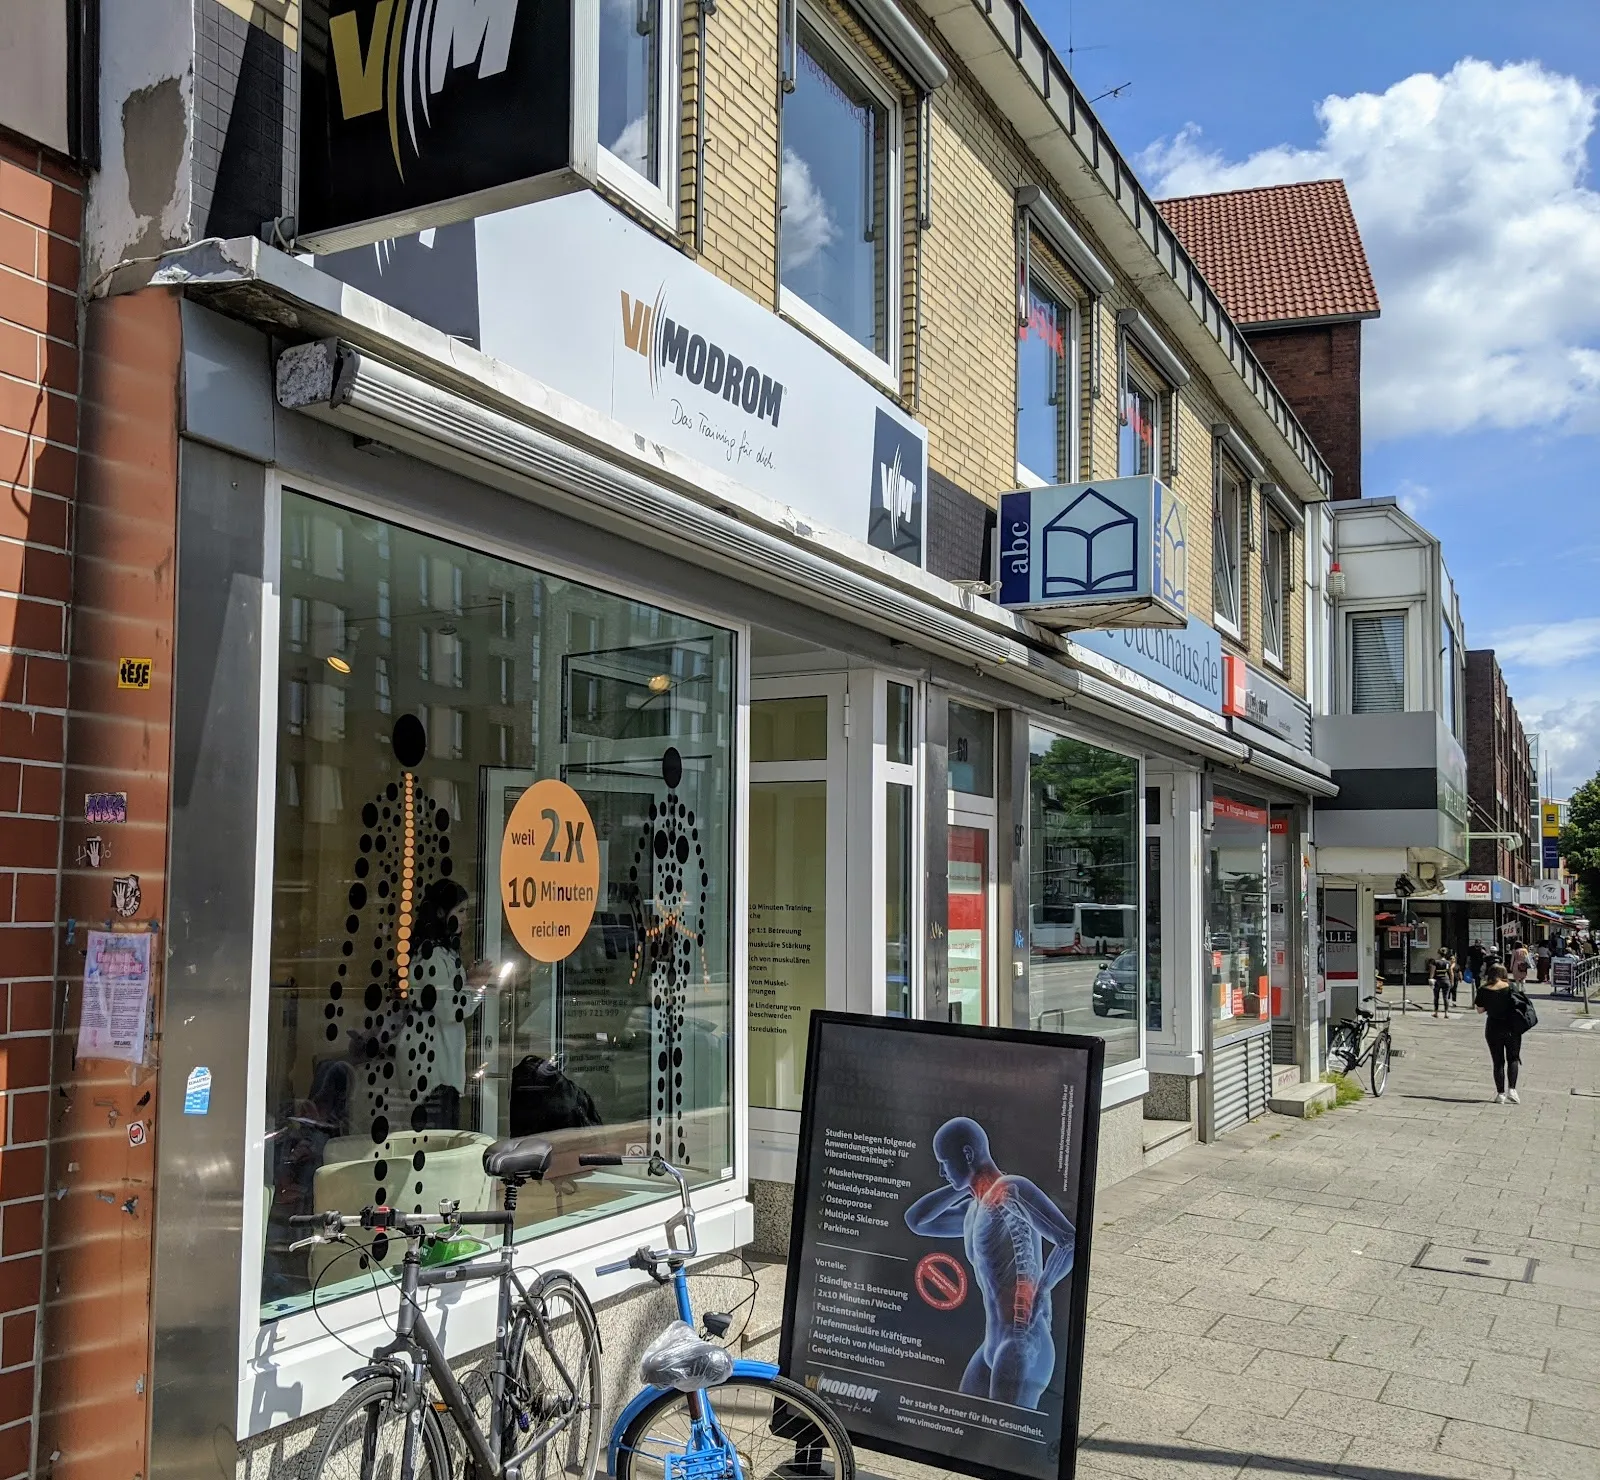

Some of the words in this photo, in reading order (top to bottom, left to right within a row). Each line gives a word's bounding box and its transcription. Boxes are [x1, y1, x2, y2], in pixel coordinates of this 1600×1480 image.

[620, 288, 785, 429] VIMODROM
[670, 398, 693, 430] Das
[698, 412, 736, 463] Training
[737, 434, 753, 464] für
[1002, 521, 1030, 574] abc
[957, 737, 968, 762] 60
[511, 828, 535, 846] weil
[508, 876, 537, 908] 10
[541, 880, 593, 902] Minuten
[1468, 882, 1486, 892] JoCo
[785, 904, 812, 913] Training
[531, 920, 571, 938] reichen
[768, 927, 802, 936] Betreuung
[781, 942, 811, 951] Stärkung
[772, 956, 811, 964] muskulären
[755, 1002, 788, 1012] Linderung
[824, 1128, 853, 1140] Studien
[853, 1131, 883, 1145] belegen
[883, 1136, 917, 1149] folgende
[824, 1139, 897, 1156] Anwendungsgebiete
[897, 1149, 910, 1159] für
[828, 1166, 911, 1188] Muskelverspannungen
[827, 1180, 899, 1200] Muskeldysbalancen
[825, 1194, 873, 1210] Osteoporose
[824, 1208, 856, 1222] Multiple
[856, 1213, 889, 1228] Sklerose
[823, 1222, 860, 1236] Parkinson
[814, 1257, 848, 1271] Vorteile:
[817, 1288, 838, 1299] 2x10
[818, 1274, 853, 1289] Ständige
[853, 1281, 866, 1292] 1:1
[866, 1284, 909, 1301] Betreuung
[816, 1302, 877, 1323] Faszientraining
[815, 1315, 880, 1337] Tiefenmuskuläre
[880, 1328, 922, 1347] Kräftigung
[811, 1344, 886, 1367] Gewichtsreduktion
[812, 1330, 851, 1346] Ausgleich
[851, 1340, 868, 1349] von
[867, 1342, 946, 1365] Muskeldysbalancen
[896, 1413, 965, 1436] www.vimodrom.de
[899, 1395, 912, 1406] Der
[911, 1398, 938, 1412] starke
[939, 1404, 968, 1420] Partner
[968, 1410, 981, 1422] für
[981, 1413, 998, 1426] Ihre
[999, 1418, 1045, 1438] Gesundheit.
